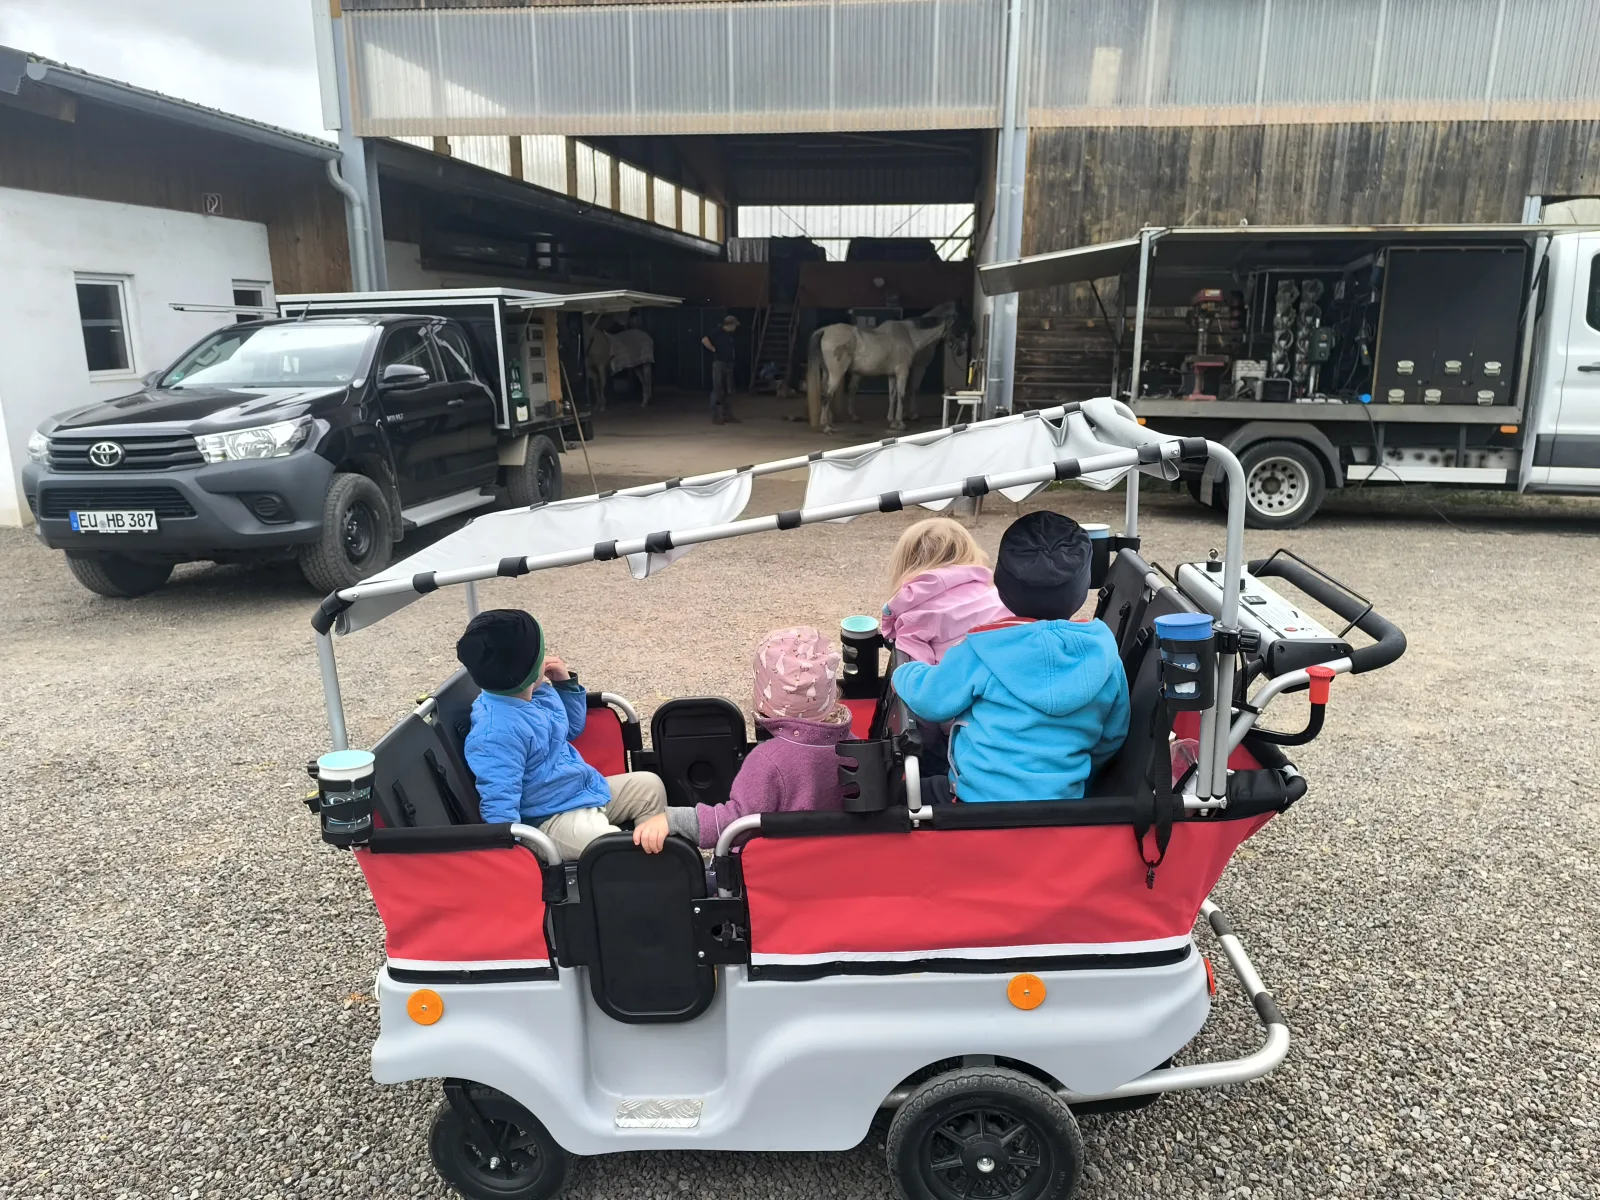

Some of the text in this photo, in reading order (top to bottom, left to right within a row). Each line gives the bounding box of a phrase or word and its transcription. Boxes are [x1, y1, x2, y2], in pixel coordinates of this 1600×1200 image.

[79, 513, 153, 528] EU HB 387
